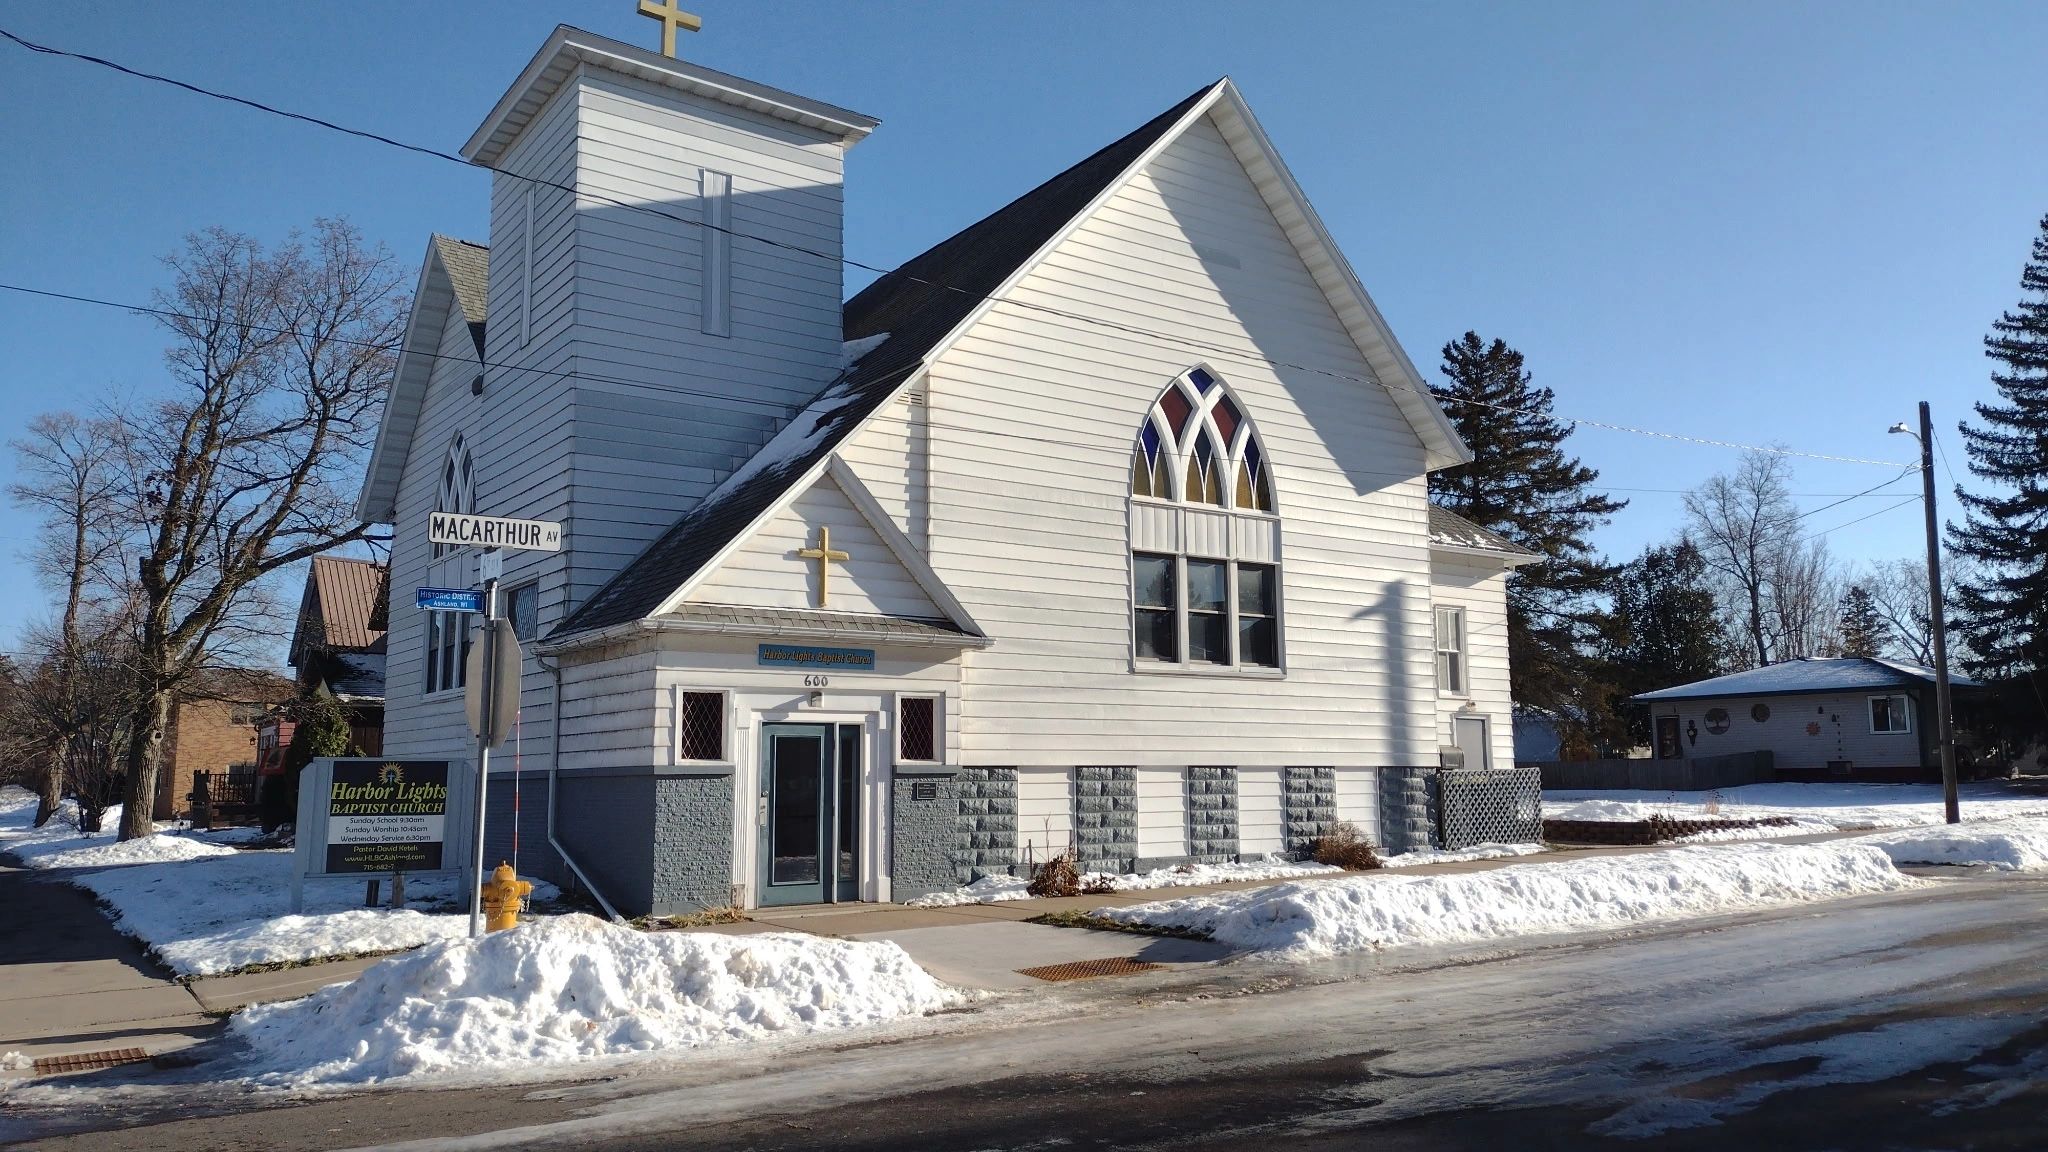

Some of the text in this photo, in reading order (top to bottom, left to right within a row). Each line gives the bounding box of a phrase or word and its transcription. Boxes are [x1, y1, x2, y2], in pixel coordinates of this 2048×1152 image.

[432, 515, 558, 547] MACARTHUR AV
[763, 648, 872, 666] Harbor Lights Baptist Church
[804, 674, 829, 687] 600
[330, 781, 448, 804] Harbor Lights
[331, 802, 444, 814] BAPTIST CHURCH
[350, 817, 375, 825] Sunday
[345, 826, 370, 834] Sunday
[353, 845, 376, 853] Pastor
